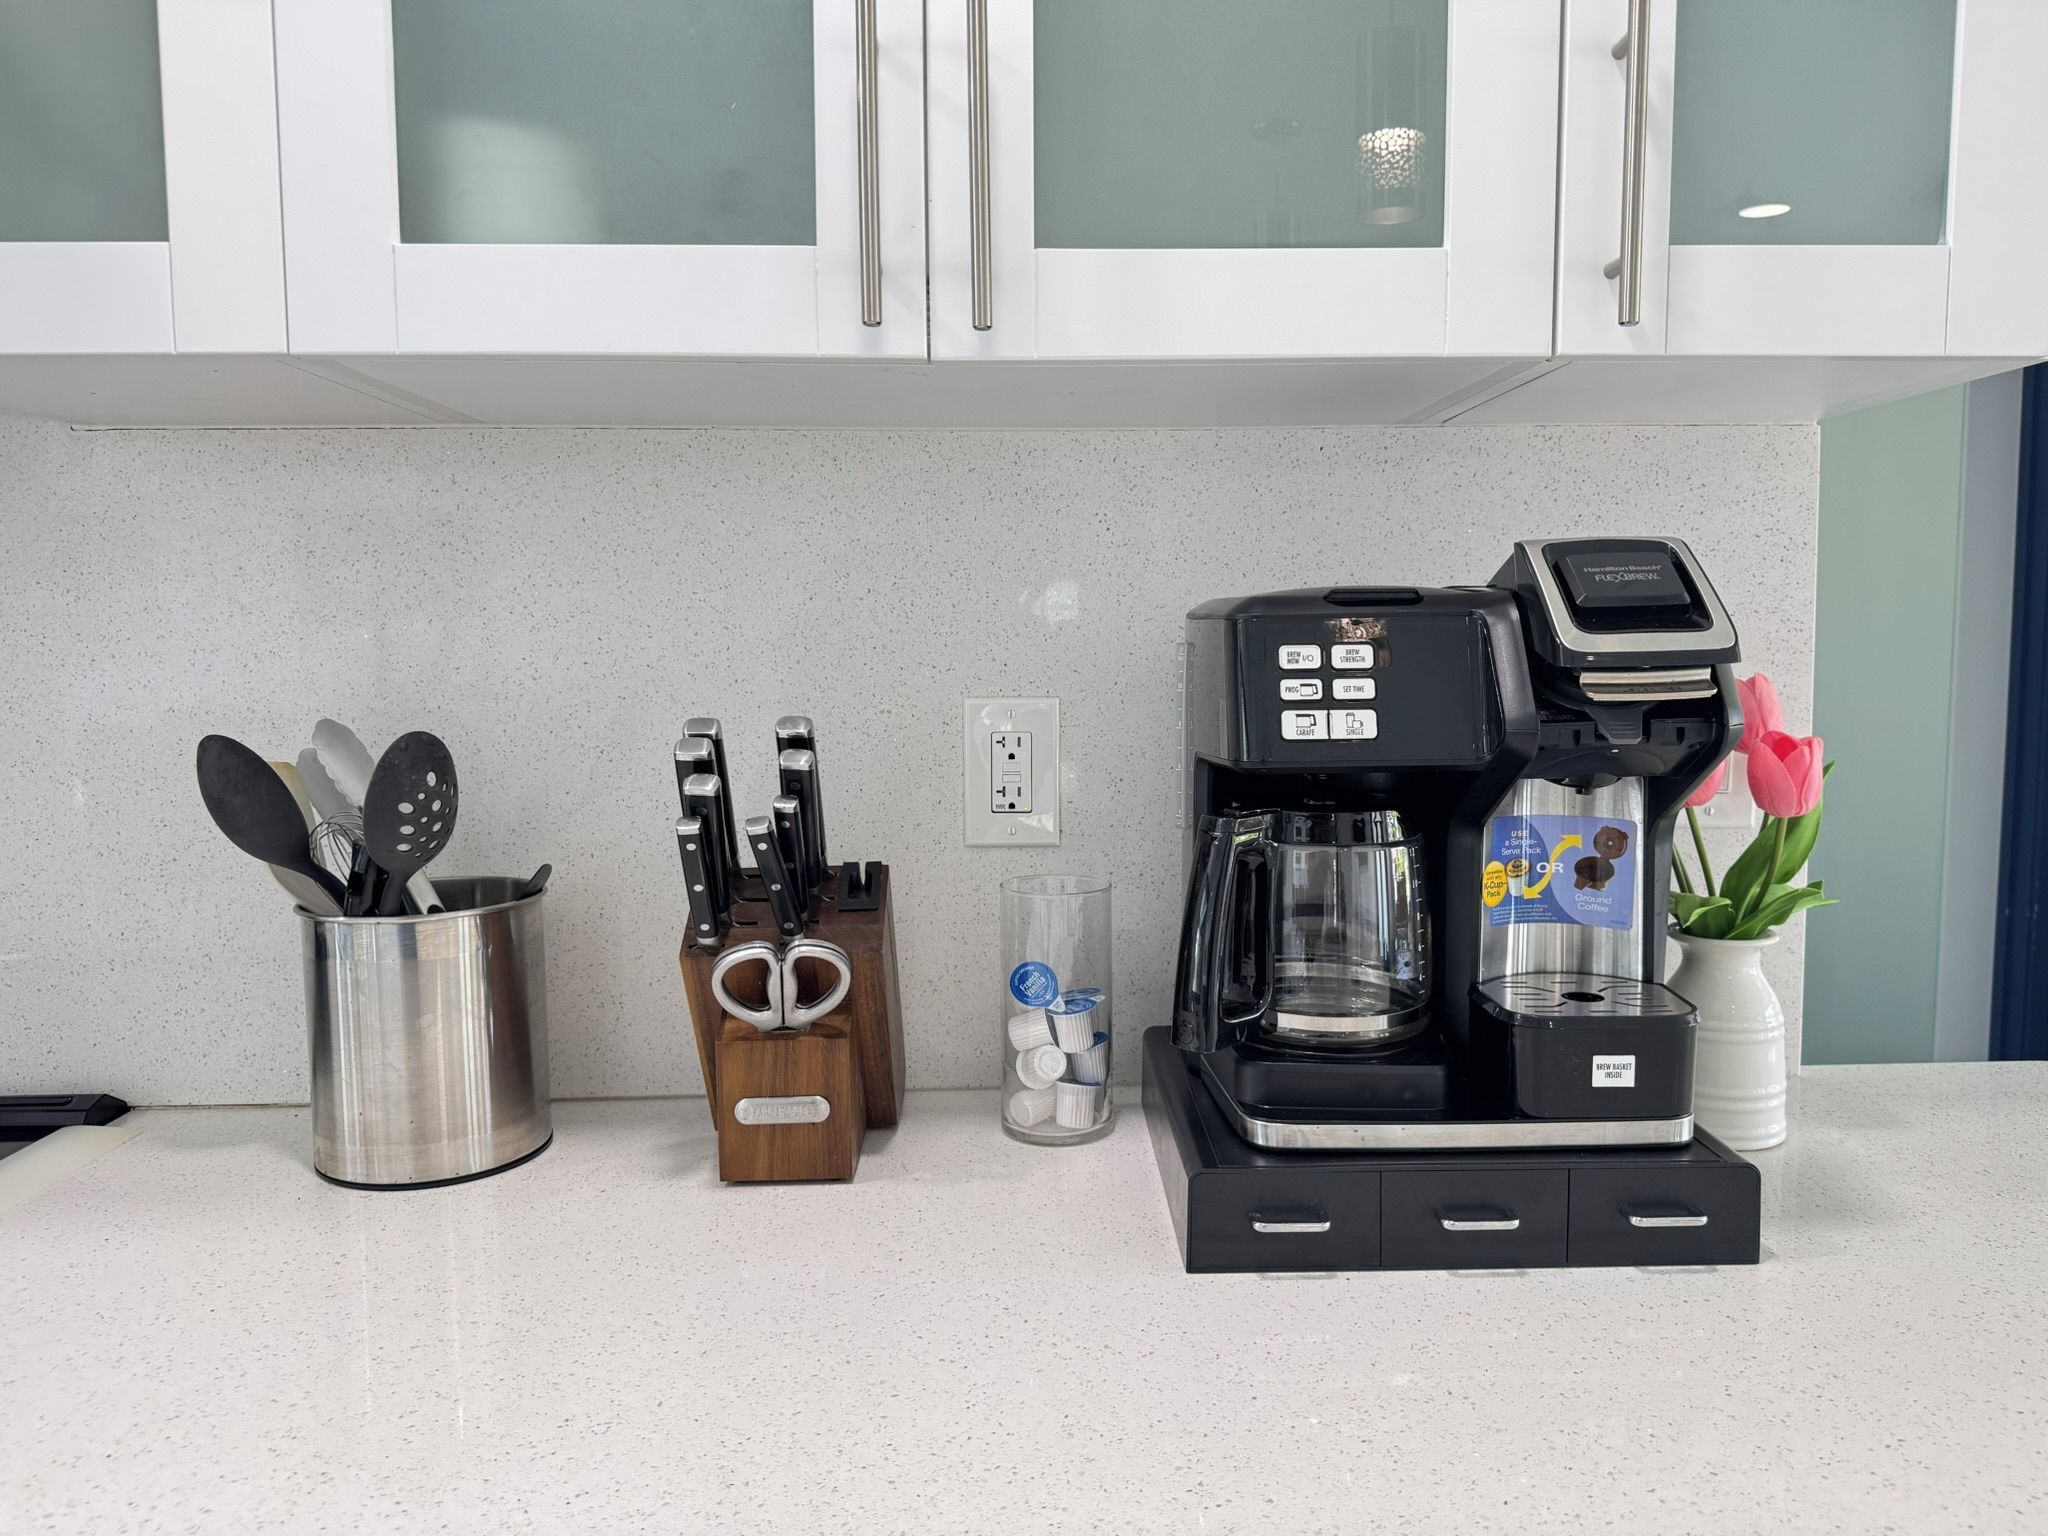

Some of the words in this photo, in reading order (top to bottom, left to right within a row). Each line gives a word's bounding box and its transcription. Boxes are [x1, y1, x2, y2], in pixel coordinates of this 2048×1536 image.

[1340, 656, 1366, 664] STRENGTH
[1285, 686, 1299, 694] PROG
[1343, 685, 1352, 693] SET
[1353, 685, 1365, 693] TIME
[1296, 729, 1315, 737] CARAFE
[1346, 728, 1364, 736] SINGLE
[1536, 862, 1564, 873] OR
[1575, 893, 1612, 905] Ground
[1577, 902, 1609, 913] Coffee
[1020, 971, 1040, 992] French
[1025, 976, 1046, 997] Vanilla
[1596, 1063, 1611, 1071] BREW
[1612, 1062, 1632, 1070] BASKET
